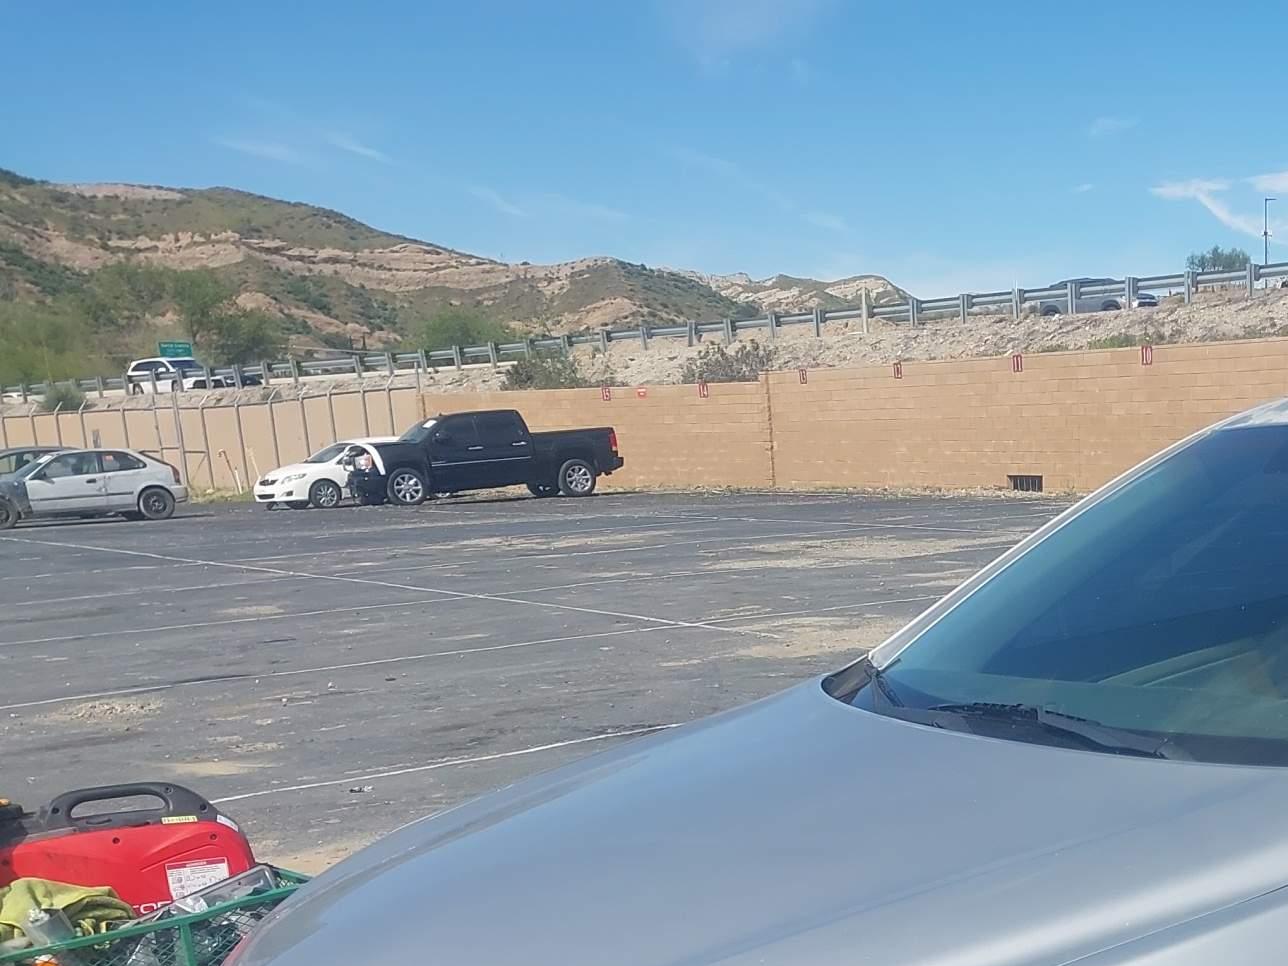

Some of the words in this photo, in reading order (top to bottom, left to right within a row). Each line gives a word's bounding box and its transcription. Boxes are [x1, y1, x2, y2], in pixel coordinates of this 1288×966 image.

[1014, 356, 1022, 370] 11
[1143, 348, 1152, 365] 10
[603, 388, 610, 400] 15
